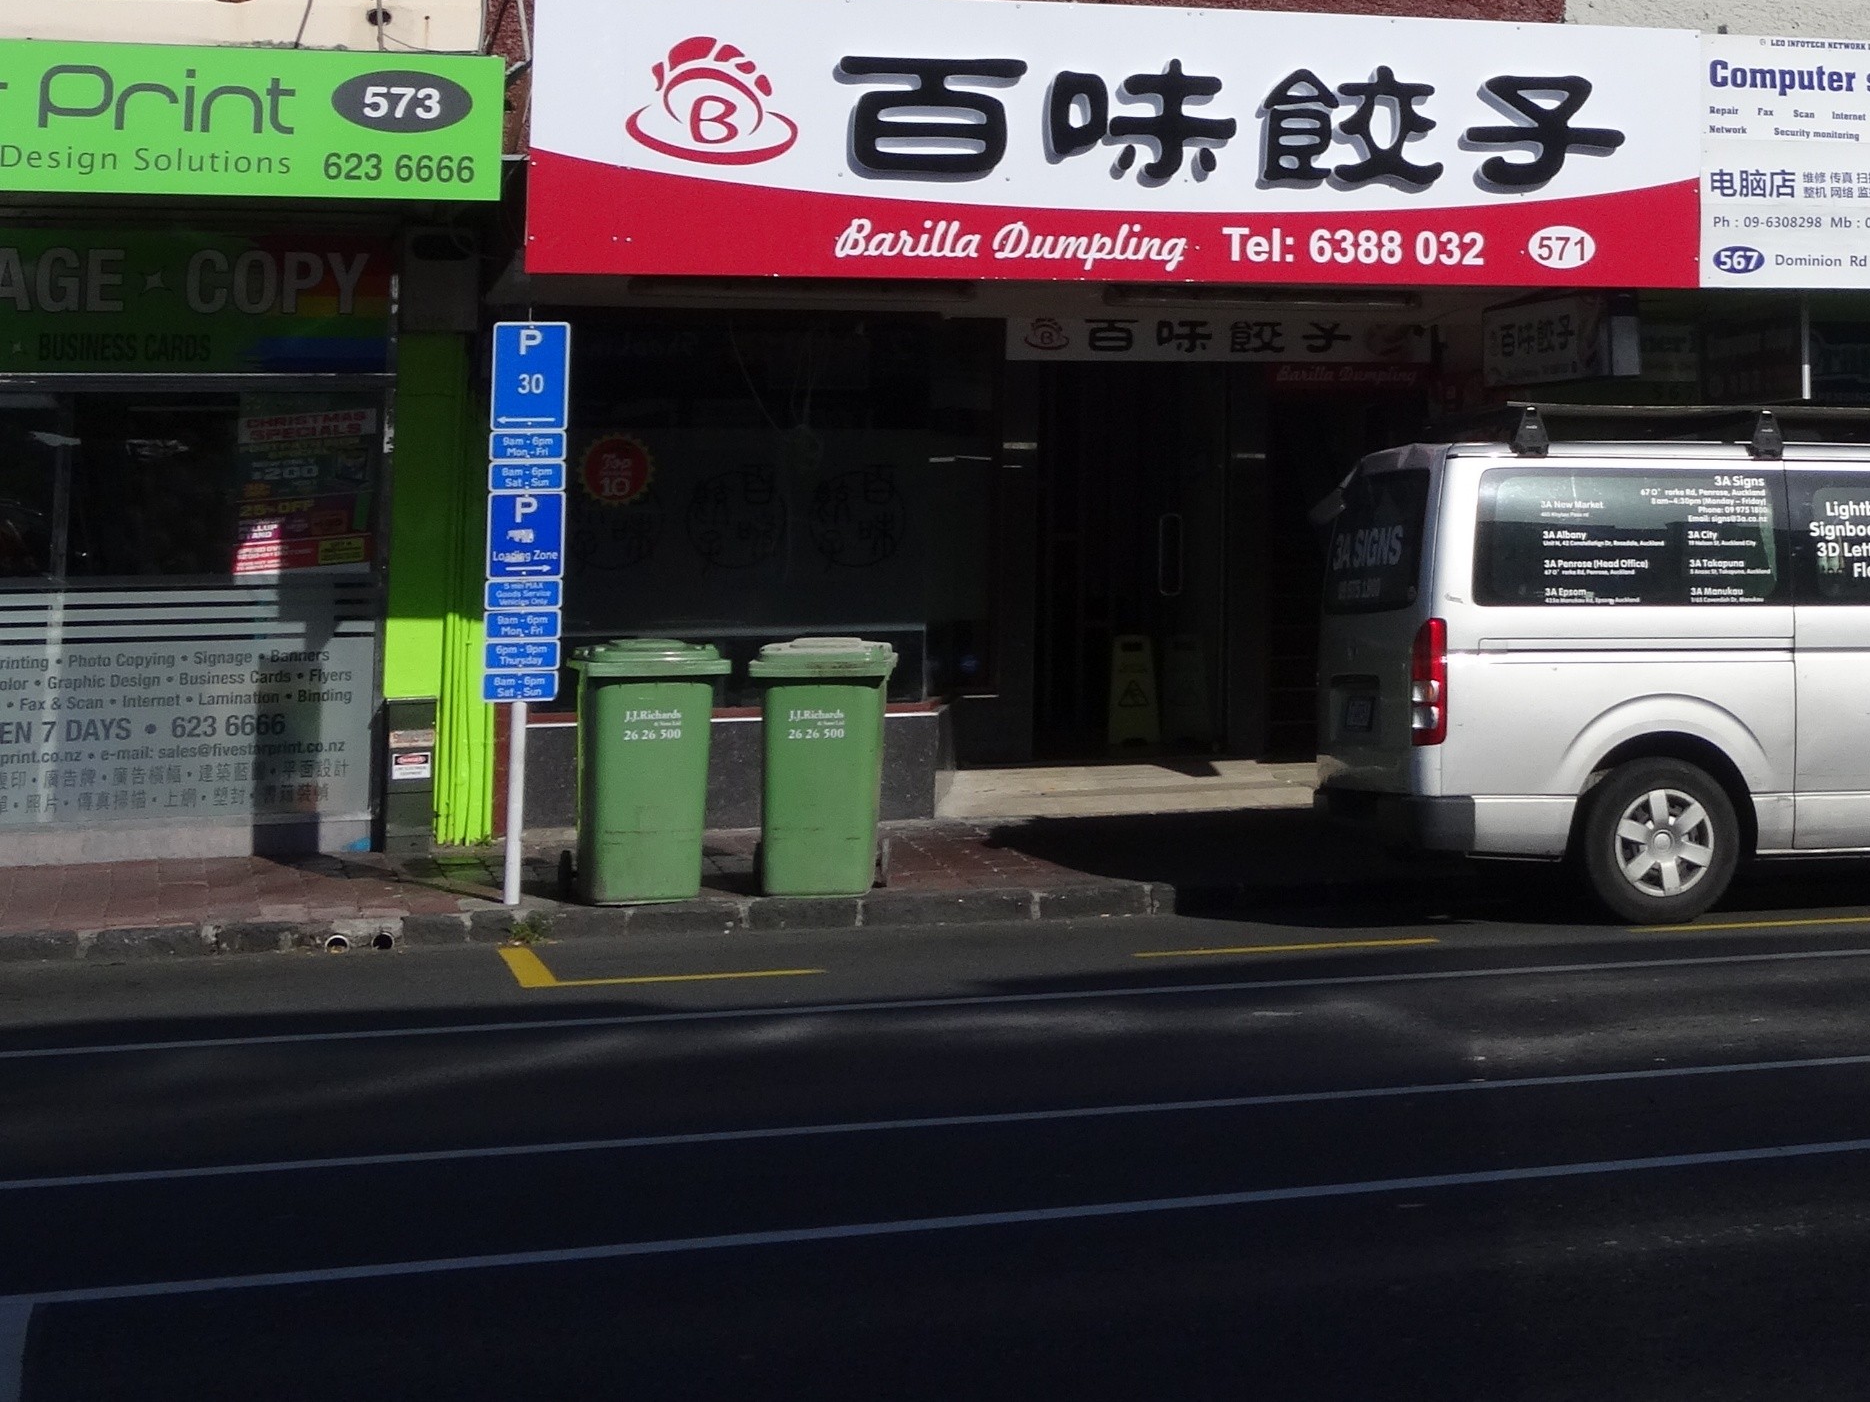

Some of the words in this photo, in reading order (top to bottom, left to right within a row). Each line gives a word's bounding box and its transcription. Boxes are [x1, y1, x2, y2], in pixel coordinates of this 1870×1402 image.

[1771, 39, 1786, 48] LEO
[1787, 39, 1826, 49] INFOTECH
[1828, 41, 1866, 51] NETWORK
[1709, 59, 1856, 96] Computer
[38, 64, 295, 135] Print
[363, 87, 441, 119] 573
[690, 95, 738, 144] B
[836, 55, 1626, 188] 百味餃子
[1709, 106, 1739, 117] Repair
[1757, 107, 1774, 117] Fax
[1793, 109, 1815, 119] Scan
[1832, 111, 1866, 121] Internet
[1709, 125, 1747, 134] Network
[1774, 127, 1811, 139] Security
[1813, 129, 1860, 141] monitoring
[1, 144, 118, 175] Design
[135, 147, 291, 175] Solutions
[323, 154, 382, 182] 623
[395, 156, 475, 184] 6666
[1710, 169, 1796, 198] 电脑店
[1803, 172, 1826, 184] 维修
[1830, 172, 1853, 184] 传真
[1803, 186, 1827, 198] 整机
[1830, 186, 1854, 198] 网络
[1713, 216, 1730, 228] Ph
[1743, 216, 1822, 228] 09-6308298
[1830, 216, 1852, 228] Mb
[834, 218, 979, 258] Barilla
[993, 221, 1187, 271] Dumpling
[1222, 227, 1295, 263] Tel:
[1309, 229, 1402, 265] 6388
[1415, 231, 1485, 266] 032
[1537, 235, 1586, 261] 571
[1720, 251, 1759, 270] 567
[1775, 254, 1842, 267] Dominion
[1850, 254, 1867, 267] Rd
[185, 249, 369, 315] COPY
[38, 332, 137, 363] BUSINESS
[144, 333, 212, 363] CARDS
[519, 329, 543, 355] P
[517, 374, 544, 394] 30
[506, 448, 527, 456] Mon
[536, 447, 548, 456] Fri
[505, 478, 522, 487] Sat
[531, 478, 549, 487] Sun
[1714, 476, 1731, 486] 3A
[1733, 475, 1765, 488] Signs
[515, 497, 538, 523] P
[1543, 530, 1555, 539] 3A
[1557, 530, 1587, 540] Albany
[533, 549, 558, 560] Zone
[1817, 543, 1840, 557] 3D
[68, 654, 111, 668] Photo
[116, 653, 176, 668] Copying
[193, 651, 252, 666] Signage
[270, 650, 330, 662] Banners
[48, 676, 106, 691] Graphic
[110, 674, 161, 689] Design
[179, 672, 245, 685] Business
[250, 671, 291, 684] Cards
[309, 669, 352, 684] Flyers
[624, 709, 682, 721] J.J.Richards
[42, 721, 56, 743] 7
[66, 717, 131, 742] DAYS
[171, 715, 217, 738] 623
[225, 713, 286, 736] 6666
[623, 730, 639, 740] 26
[641, 729, 656, 740] 26
[659, 729, 681, 739] 500
